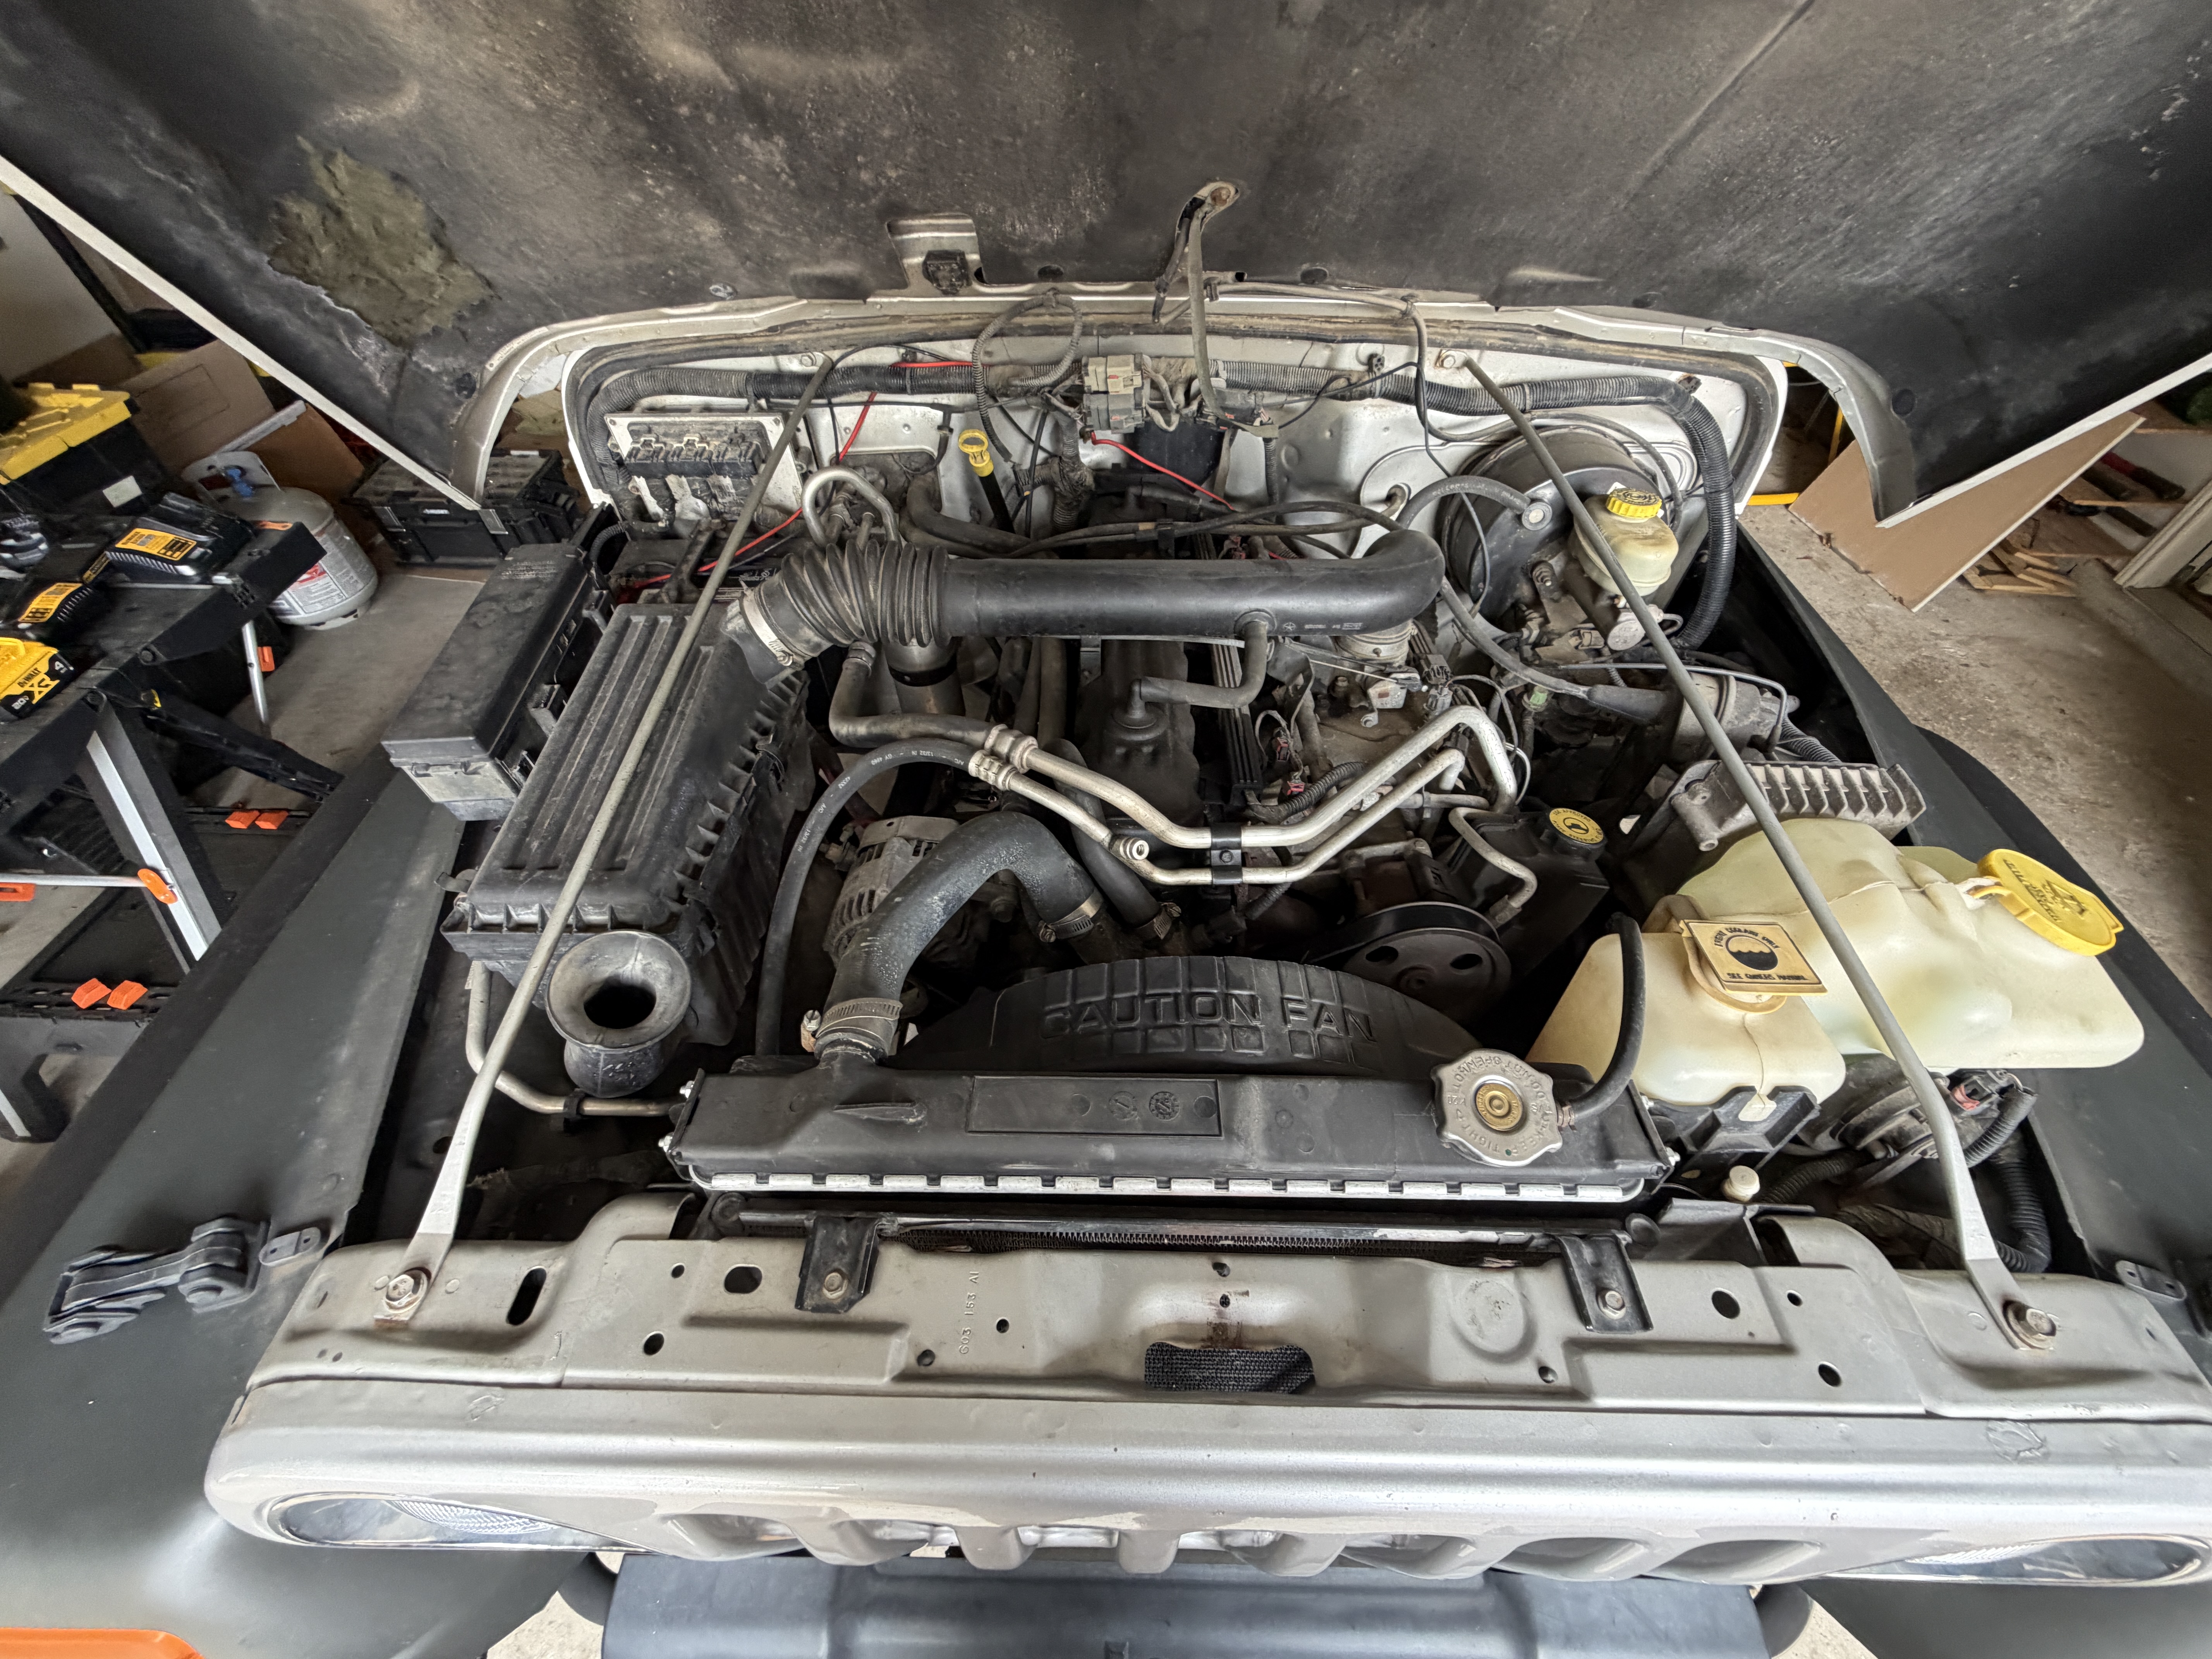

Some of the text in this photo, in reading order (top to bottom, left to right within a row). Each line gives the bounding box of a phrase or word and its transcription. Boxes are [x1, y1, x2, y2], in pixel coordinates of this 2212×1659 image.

[24, 676, 60, 704] XR
[1040, 993, 1377, 1042] CAUTION FAN
[1462, 1124, 1499, 1152] TIGHT
[964, 1292, 976, 1315] 153
